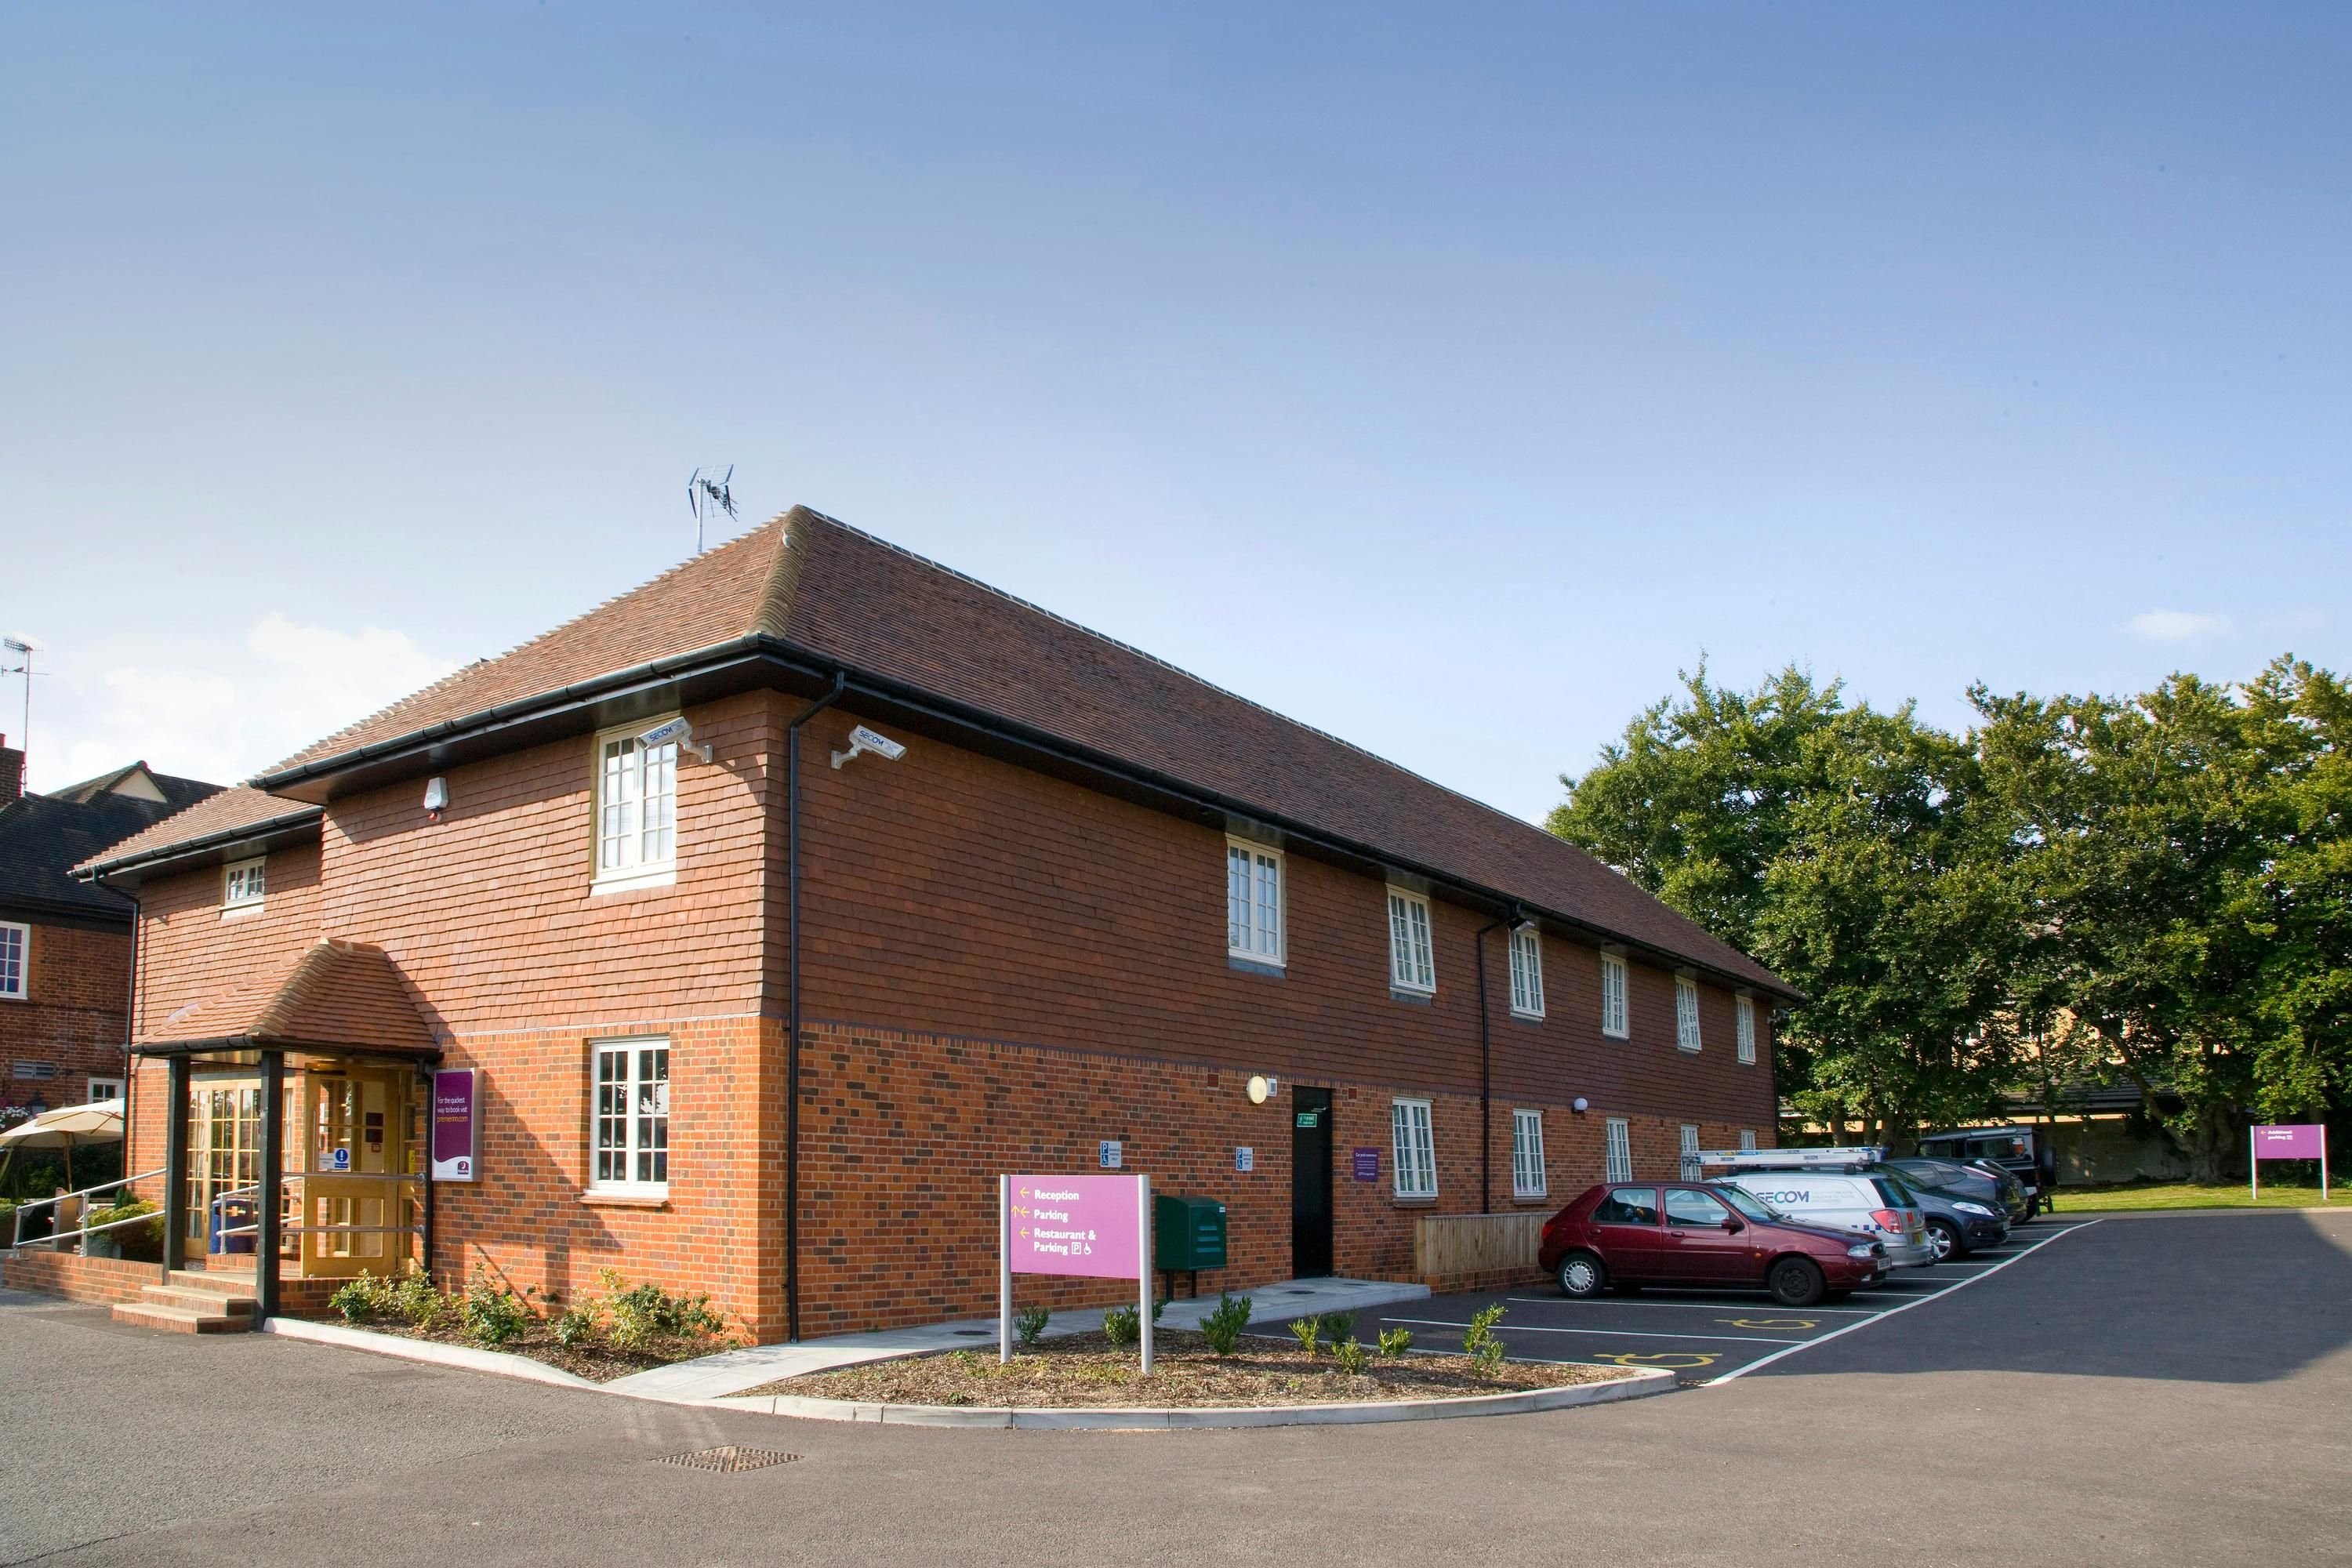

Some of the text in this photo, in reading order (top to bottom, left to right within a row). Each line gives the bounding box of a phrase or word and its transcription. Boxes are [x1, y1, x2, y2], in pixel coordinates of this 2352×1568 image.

[649, 726, 673, 742] SECOM
[858, 730, 884, 746] SECOM
[1034, 1189, 1080, 1203] Reception
[1756, 1191, 1809, 1203] SECOM
[1033, 1209, 1069, 1223] Parking
[1033, 1227, 1097, 1240] Restaurant &
[1033, 1241, 1069, 1255] Parking
